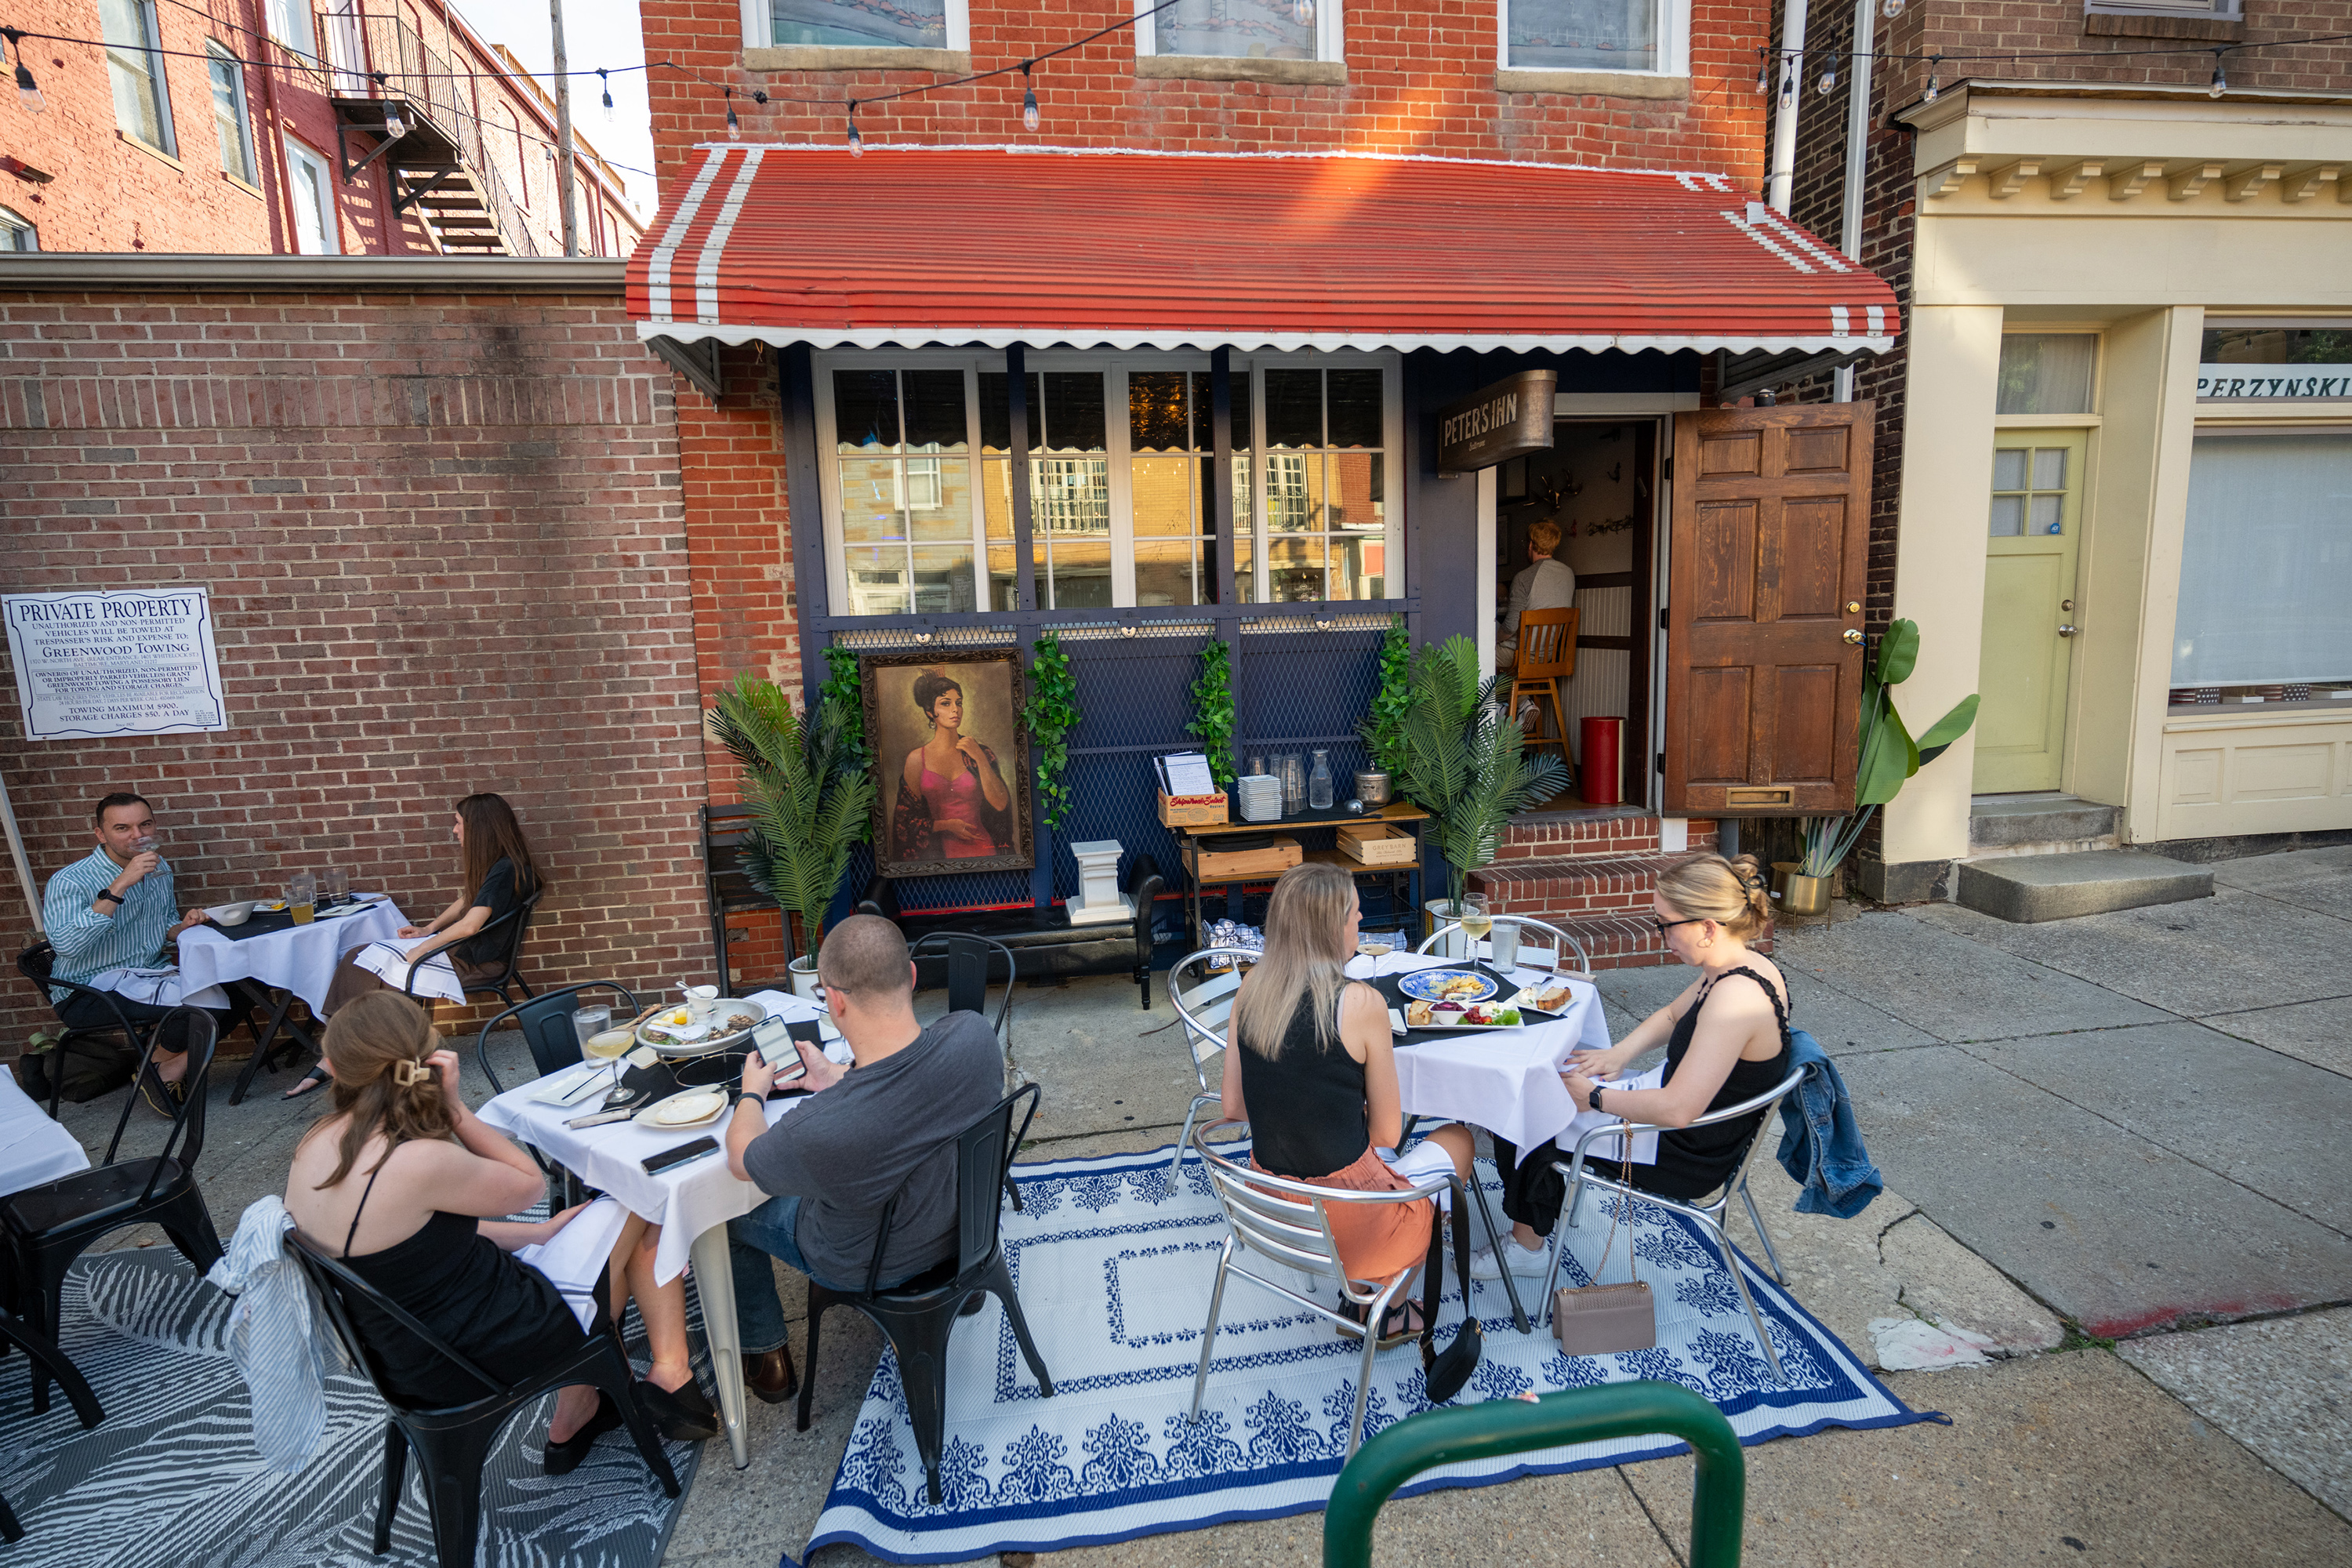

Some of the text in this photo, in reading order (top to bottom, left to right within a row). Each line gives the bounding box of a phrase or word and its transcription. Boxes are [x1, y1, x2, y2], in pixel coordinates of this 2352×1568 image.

[2197, 377, 2350, 397] PERZYNSKI
[1444, 392, 1517, 447] PETER'S INN
[20, 599, 191, 622] PRIVATE PROPERTY
[32, 621, 97, 630] UNAUTHORIZED
[120, 618, 185, 626] NON-PERMITTED
[34, 637, 91, 645] TRESPASSER'S
[42, 643, 190, 658] GREENWOOD TOWING
[69, 706, 105, 714] TOWING
[107, 703, 154, 712] MAXIMUM
[60, 713, 99, 722] STORAGE
